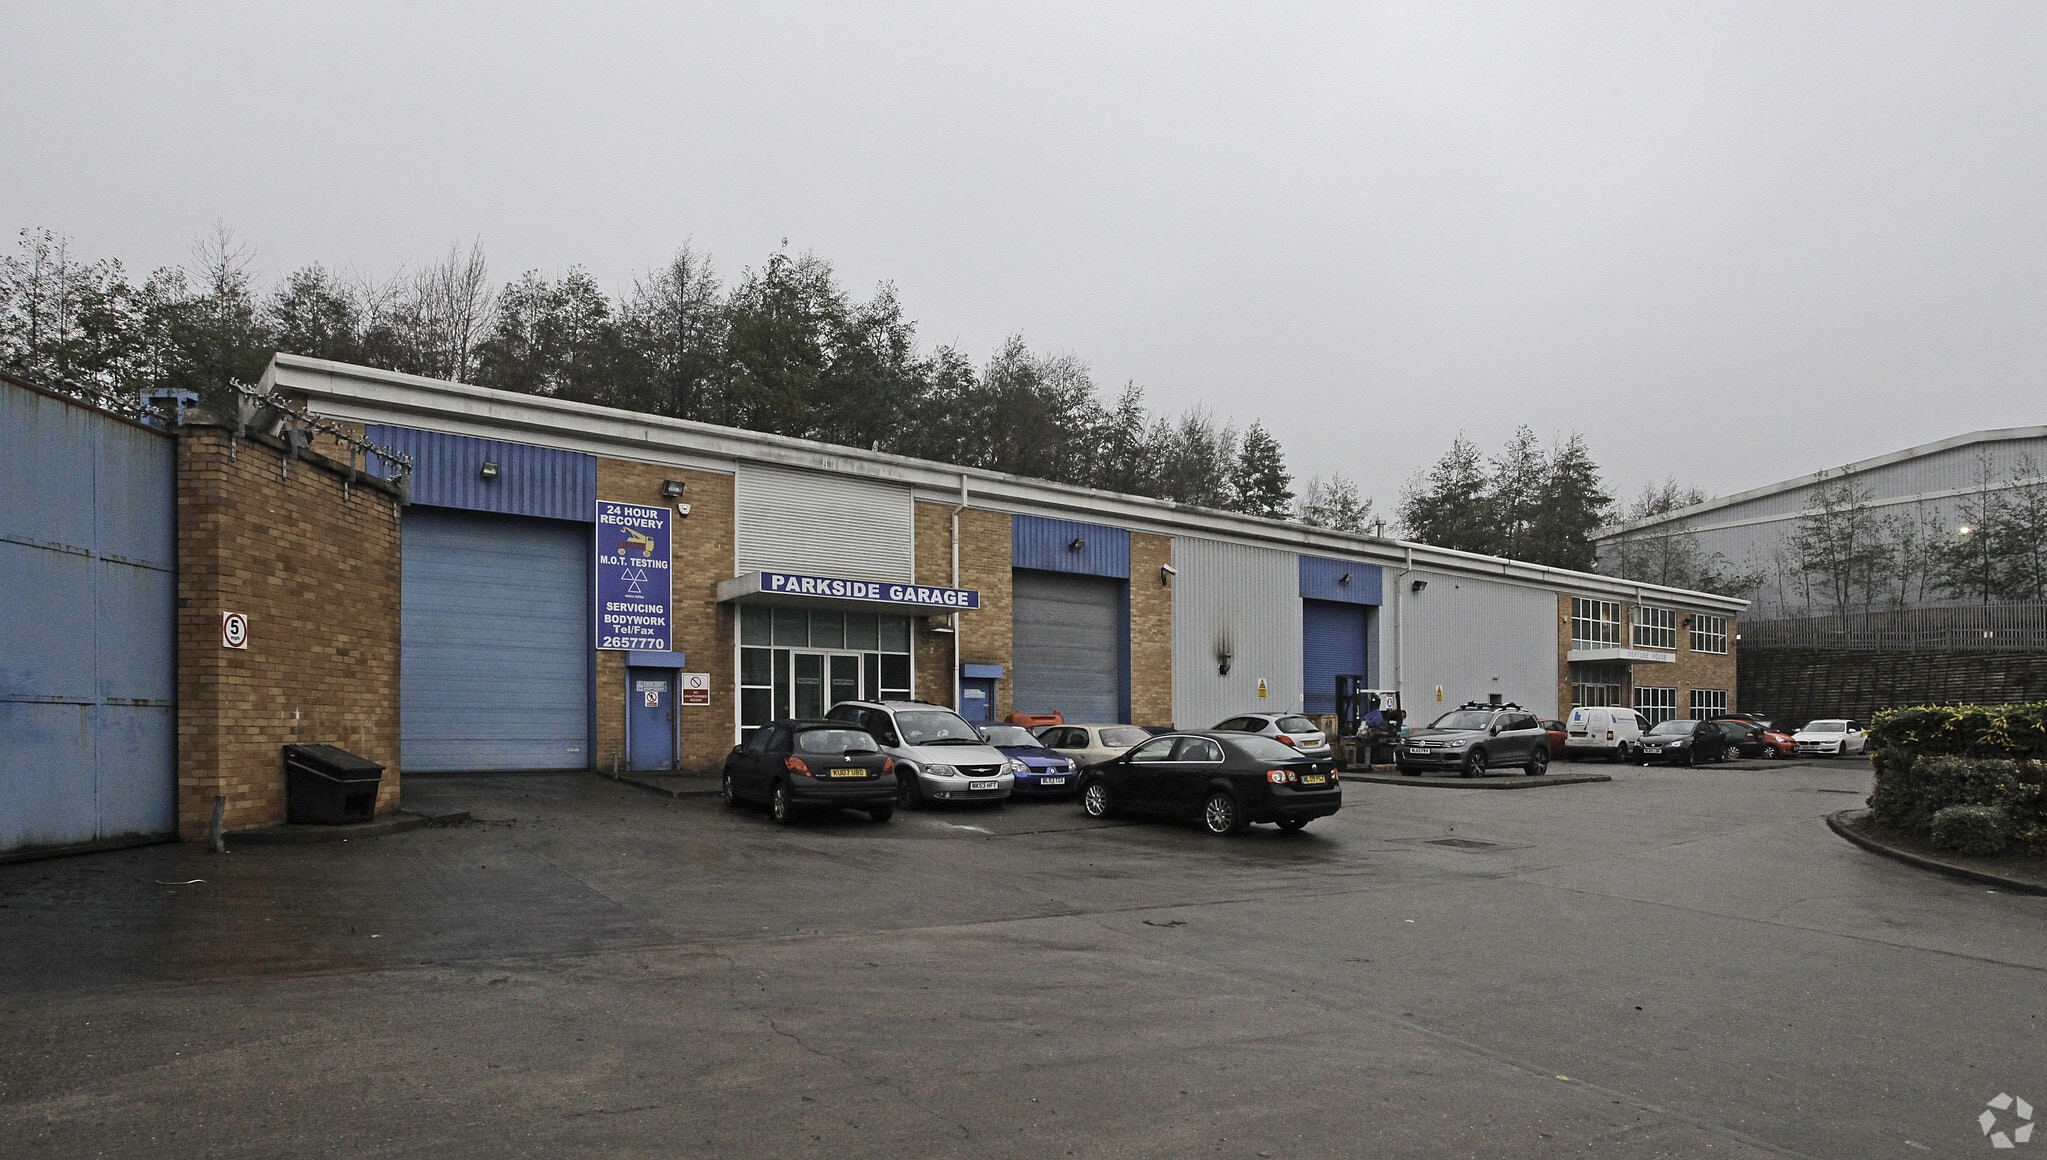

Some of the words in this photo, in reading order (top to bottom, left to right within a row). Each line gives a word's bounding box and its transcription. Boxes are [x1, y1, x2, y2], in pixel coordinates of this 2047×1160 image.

[607, 505, 621, 515] 24
[625, 507, 658, 519] HOUR
[600, 514, 664, 529] RECOVERY
[600, 555, 627, 566] M.O.T.
[630, 557, 668, 569] TESTING
[771, 574, 880, 599] PARKSIDE
[889, 586, 969, 606] GARAGE
[606, 602, 664, 613] SERVICING
[230, 619, 239, 635] 5
[604, 614, 666, 626] BODYWORK
[613, 625, 654, 635] Tel/Fax
[603, 636, 664, 649] 2657770
